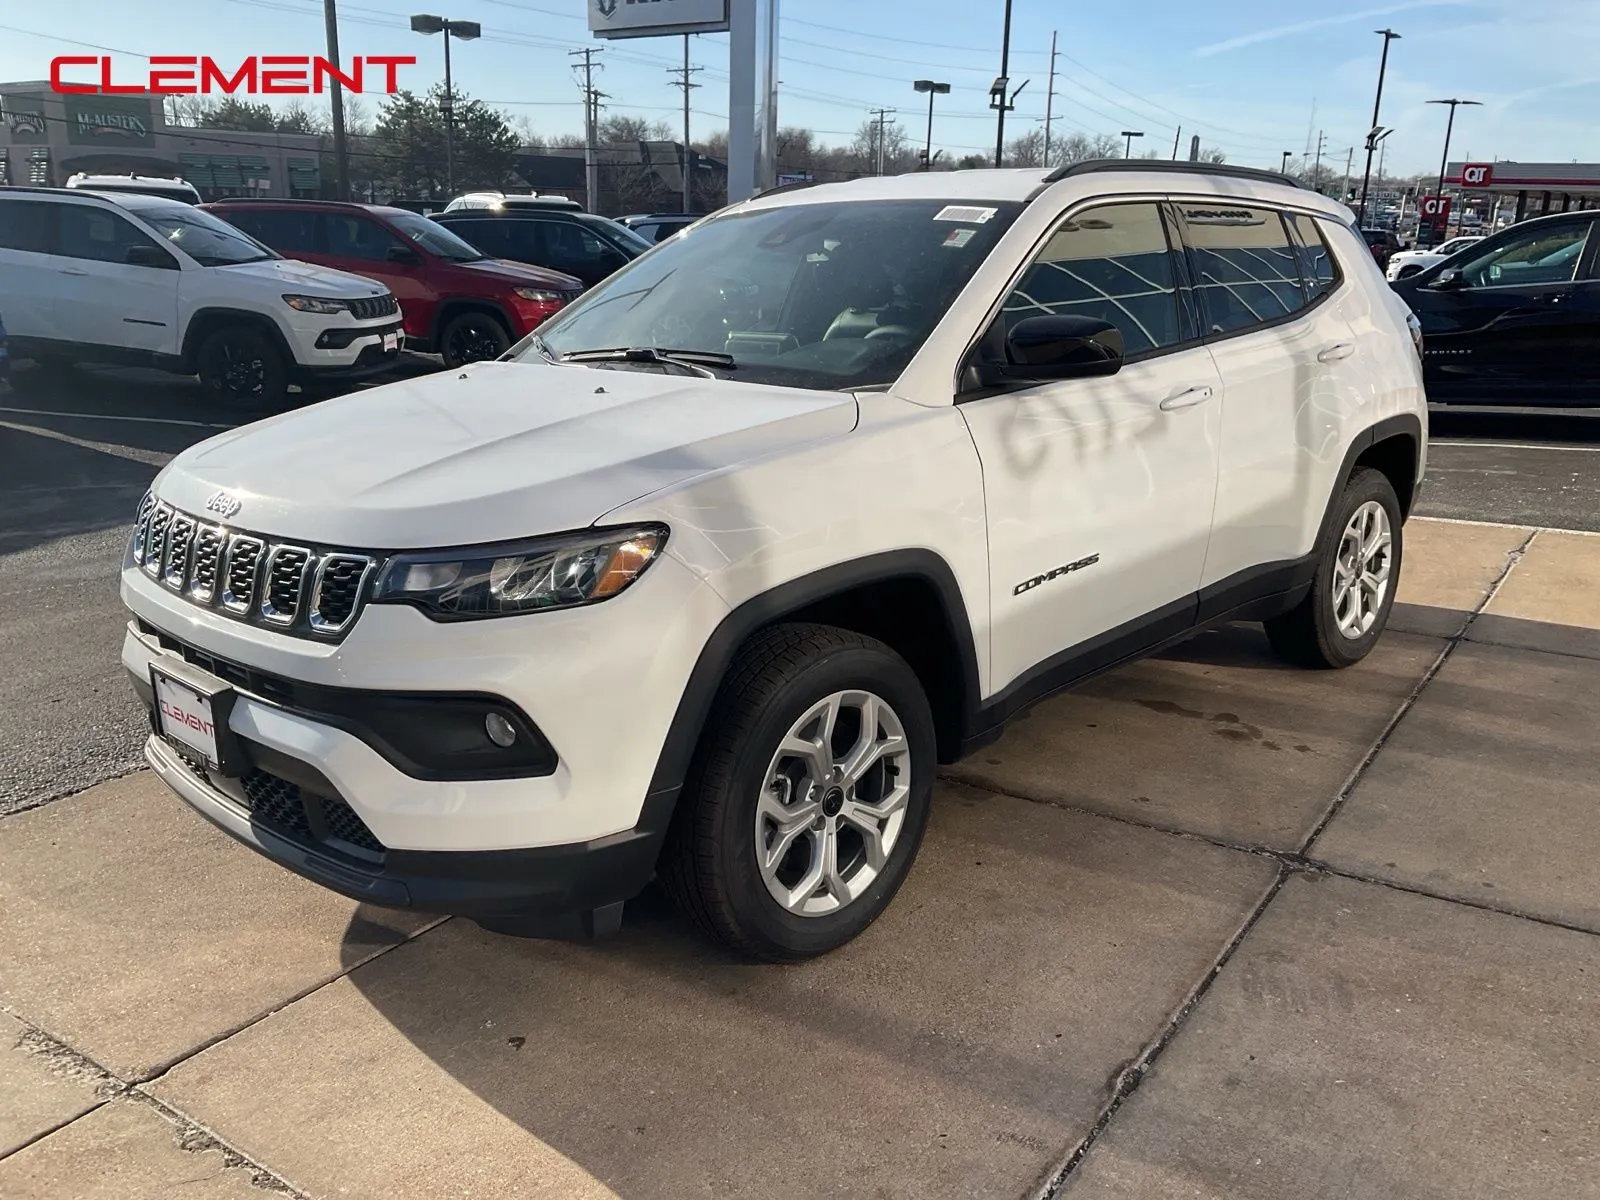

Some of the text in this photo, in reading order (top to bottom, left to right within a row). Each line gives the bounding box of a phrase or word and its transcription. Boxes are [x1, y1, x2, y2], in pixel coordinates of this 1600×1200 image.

[1464, 167, 1487, 183] QT
[1425, 199, 1446, 214] QT
[206, 490, 241, 519] Jeep
[1013, 553, 1100, 596] COMPASS
[160, 699, 215, 737] CLEMENT
